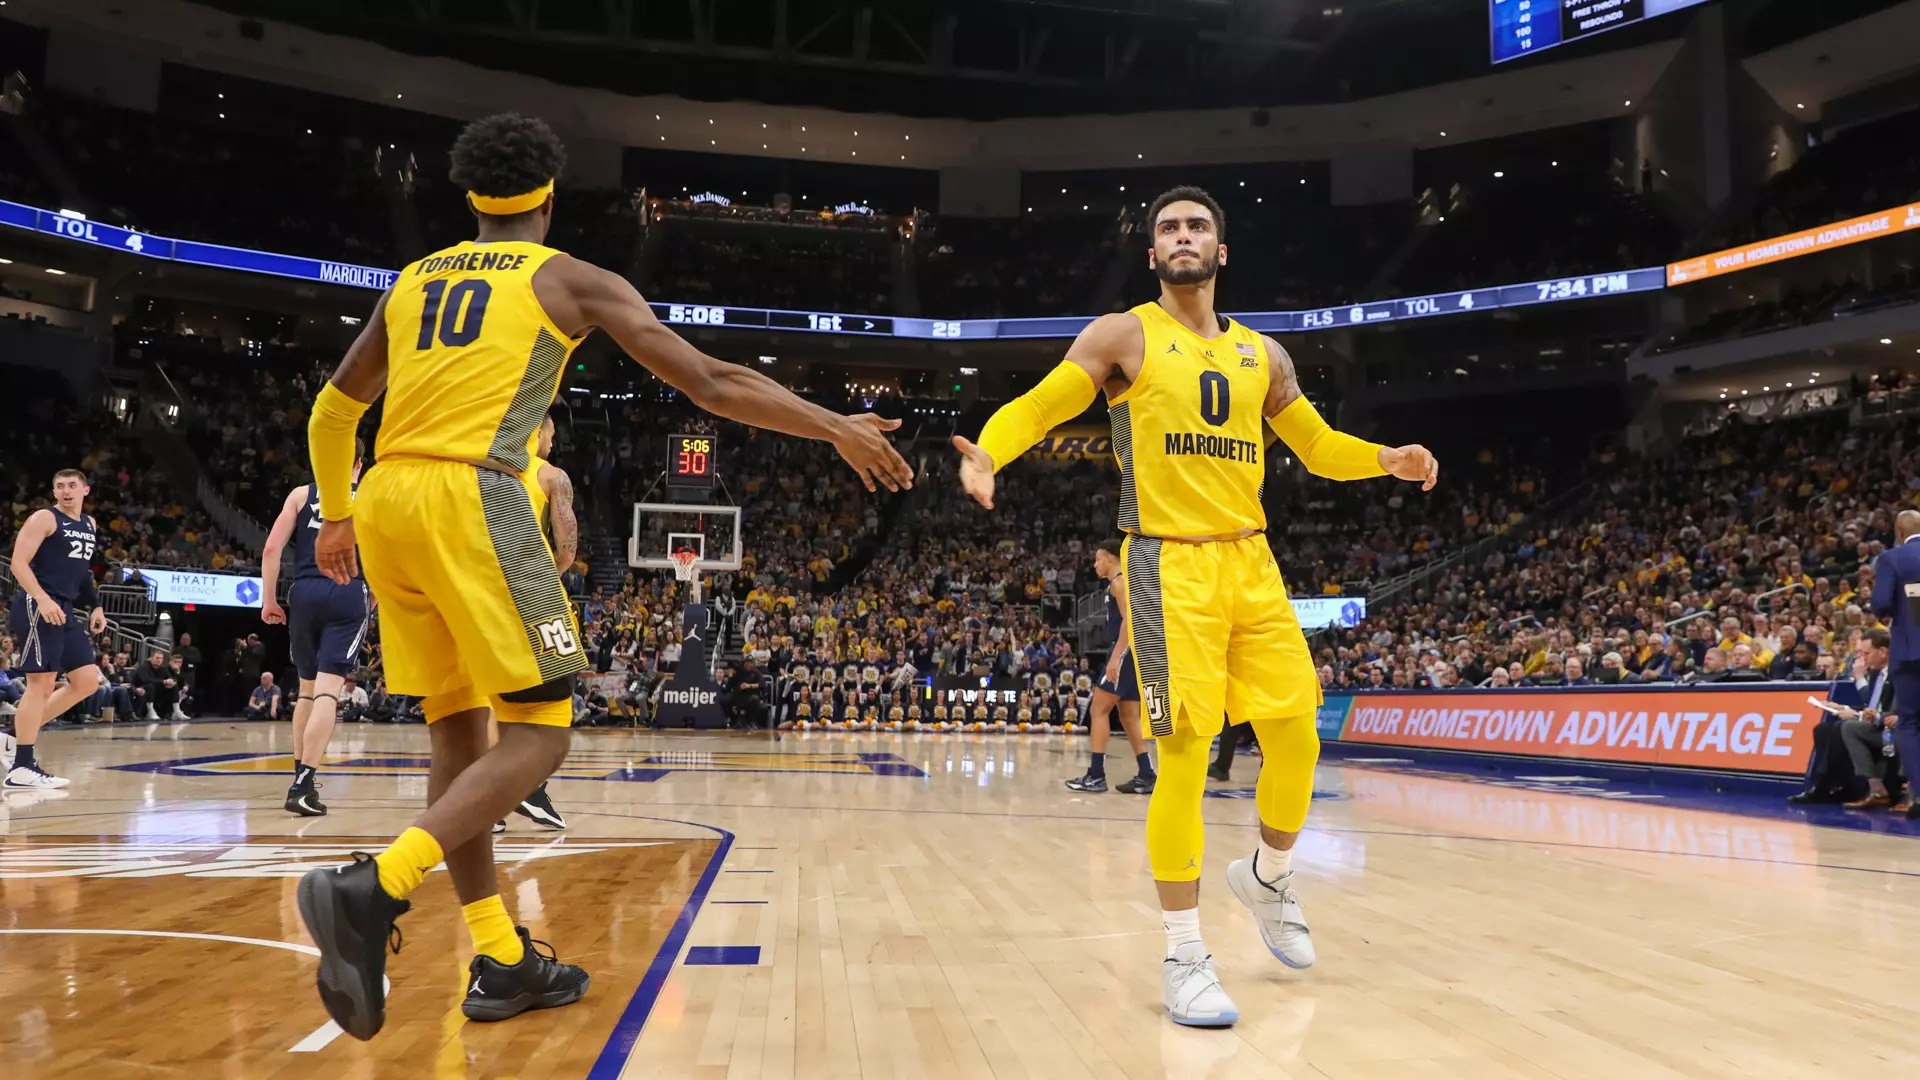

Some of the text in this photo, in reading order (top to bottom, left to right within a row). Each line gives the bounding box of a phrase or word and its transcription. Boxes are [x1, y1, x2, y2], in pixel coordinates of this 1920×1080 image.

[1572, 6, 1592, 19] FREE
[1580, 10, 1624, 30] REBOUNDS
[1515, 26, 1532, 38] 100
[1520, 38, 1532, 50] 15
[53, 215, 144, 252] TOL 4
[1714, 252, 1745, 269] YOUR
[1746, 235, 1815, 262] HOMETOWN
[1816, 216, 1890, 245] ADVANTAGE
[415, 252, 528, 275] TORRENCE
[320, 263, 393, 289] MARQUETTE
[1537, 273, 1628, 300] 7:34 PM
[416, 278, 493, 351] 10
[669, 305, 725, 325] 5:06
[1405, 293, 1474, 315] TOL 4
[808, 314, 842, 331] 1st
[1303, 311, 1334, 328] FLS
[1350, 306, 1364, 323] 6
[932, 322, 961, 337] 25
[1199, 370, 1230, 427] 0
[682, 439, 710, 452] 5:06
[1165, 433, 1257, 464] MARQUETTE
[678, 452, 706, 474] 30
[63, 529, 96, 542] XAVIER
[68, 540, 95, 560] 25
[170, 585, 217, 596] REGENCY
[171, 574, 218, 586] HYATT
[535, 617, 577, 656] MU
[663, 686, 717, 708] meijer
[1351, 707, 1403, 735] YOUR
[1403, 708, 1555, 743] HOMETOWN
[1554, 710, 1802, 756] ADVANTAGE
